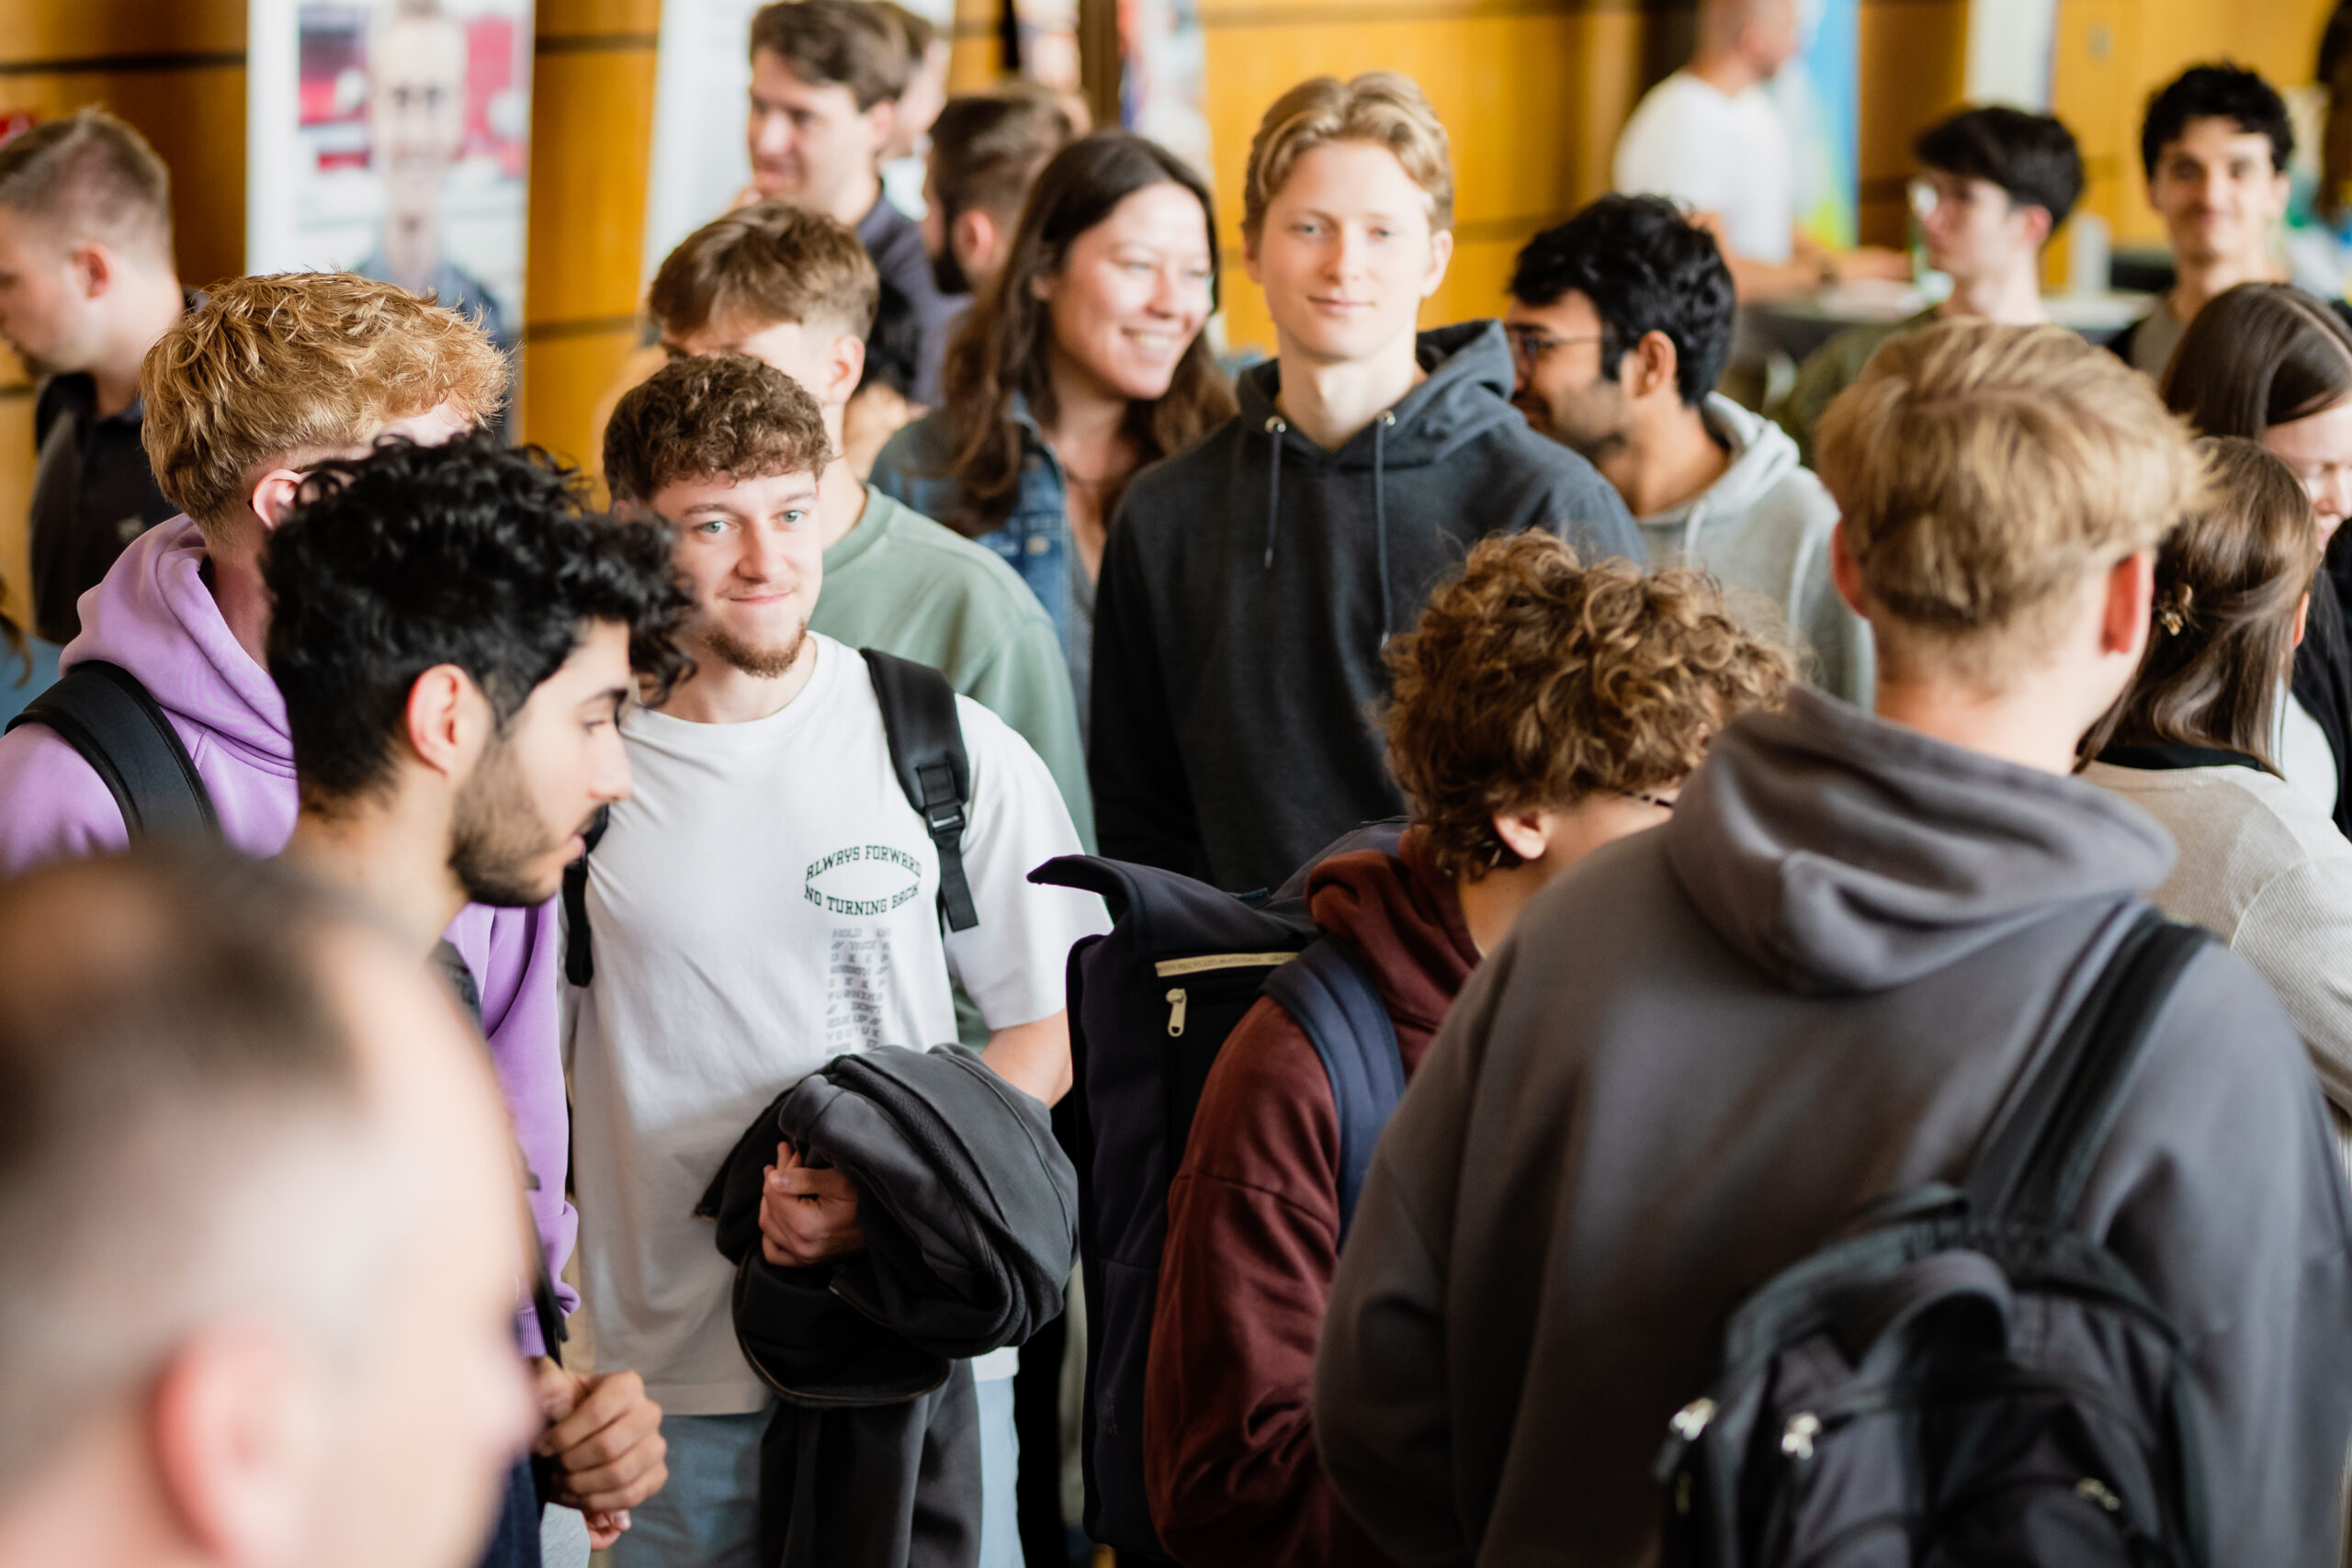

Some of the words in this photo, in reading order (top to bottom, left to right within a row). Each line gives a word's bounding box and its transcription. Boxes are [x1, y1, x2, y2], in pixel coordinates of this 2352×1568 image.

[806, 846, 861, 881] ALWAYS
[865, 845, 922, 878] FORWARD
[805, 883, 822, 906] NO
[827, 896, 888, 915] TURNING
[891, 881, 920, 909] BACK
